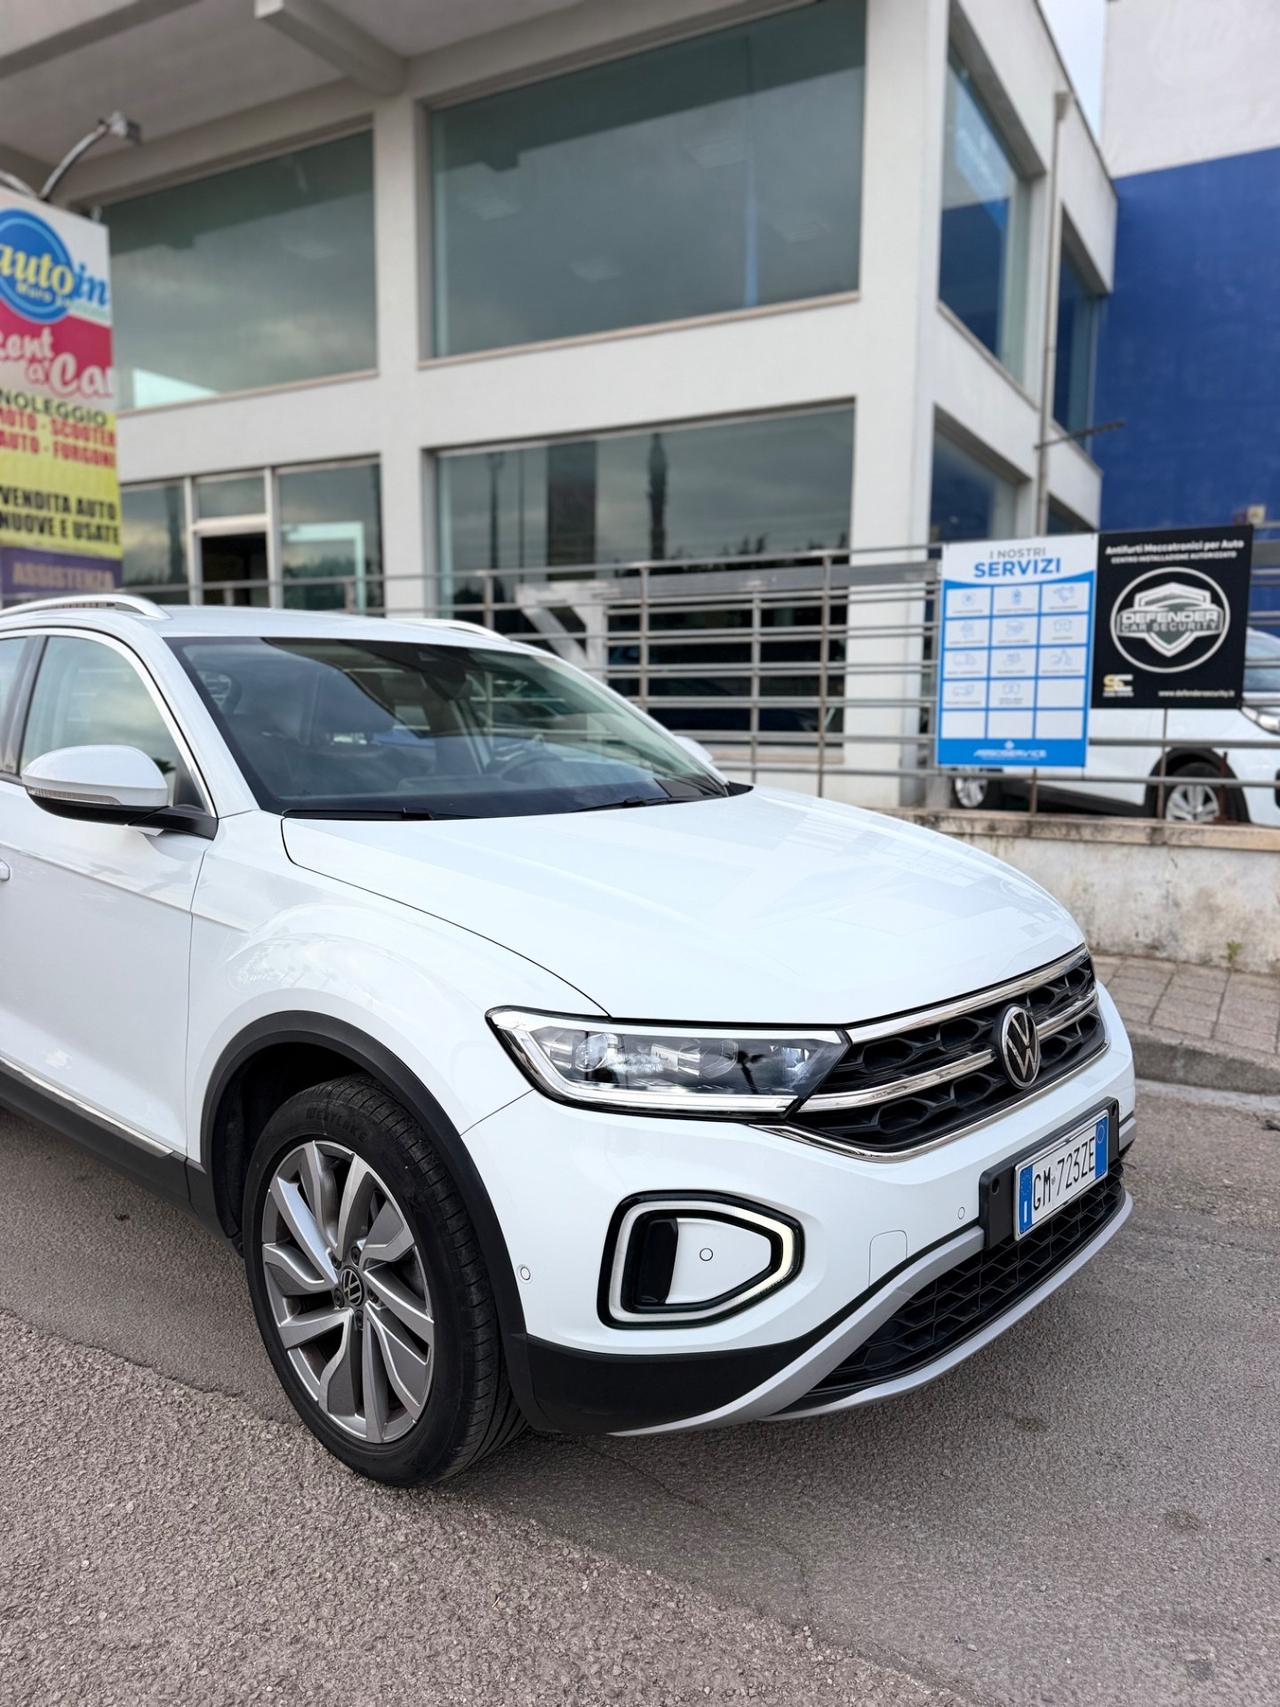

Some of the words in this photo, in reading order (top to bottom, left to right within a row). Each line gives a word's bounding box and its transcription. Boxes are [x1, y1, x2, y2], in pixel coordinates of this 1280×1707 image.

[0, 389, 107, 427] NOLEGGIO
[0, 486, 70, 514] VENDITA
[76, 498, 116, 520] AUTO
[60, 518, 67, 539] E
[73, 521, 119, 545] USATE
[997, 547, 1046, 559] NOSTRI
[1105, 543, 1143, 555] Antifurti
[1204, 540, 1219, 552] per
[1221, 539, 1245, 550] Auto
[974, 557, 1061, 578] SERVIZI
[1121, 610, 1219, 624] DEFENDER
[1122, 622, 1148, 632] CAR
[1152, 621, 1218, 632] SECURITY
